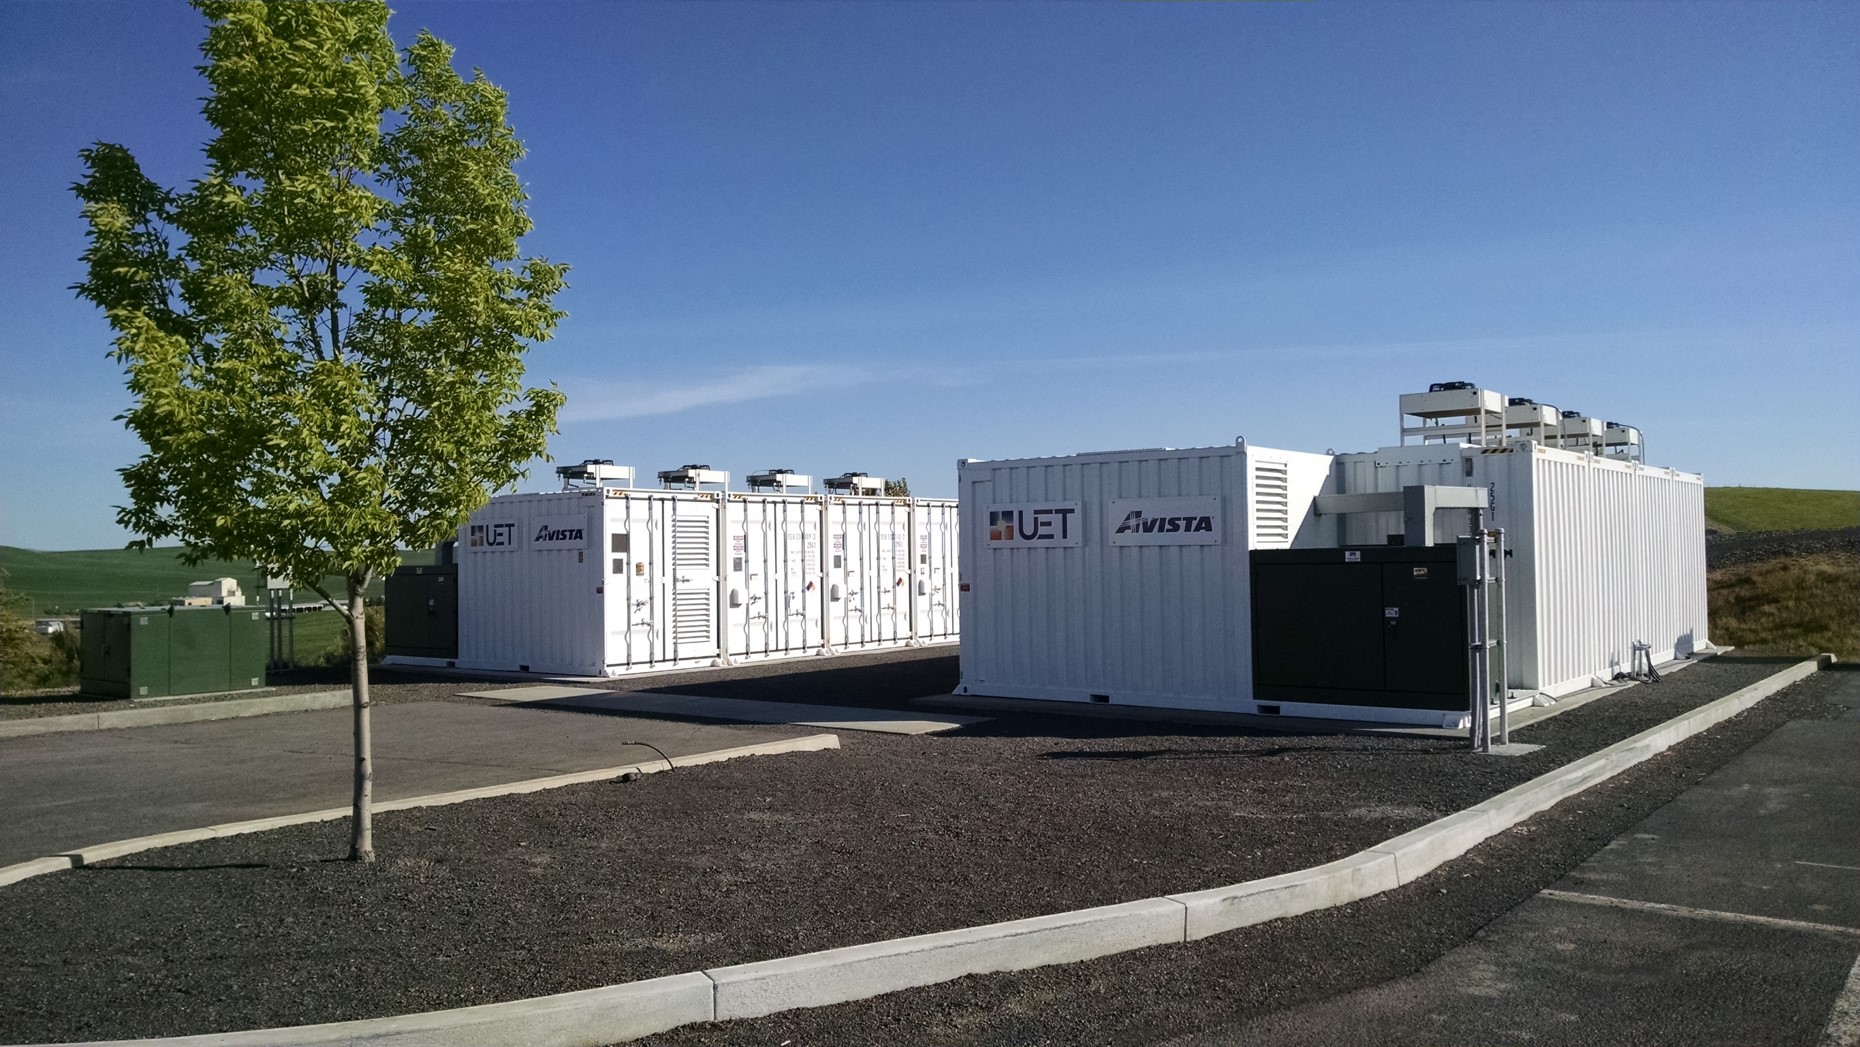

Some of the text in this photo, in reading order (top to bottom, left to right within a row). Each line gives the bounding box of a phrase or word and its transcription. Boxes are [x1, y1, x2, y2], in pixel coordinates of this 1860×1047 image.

[486, 523, 515, 546] UET
[534, 524, 584, 542] AVISTA
[1018, 508, 1076, 541] UET
[1115, 510, 1214, 535] AVISTA
